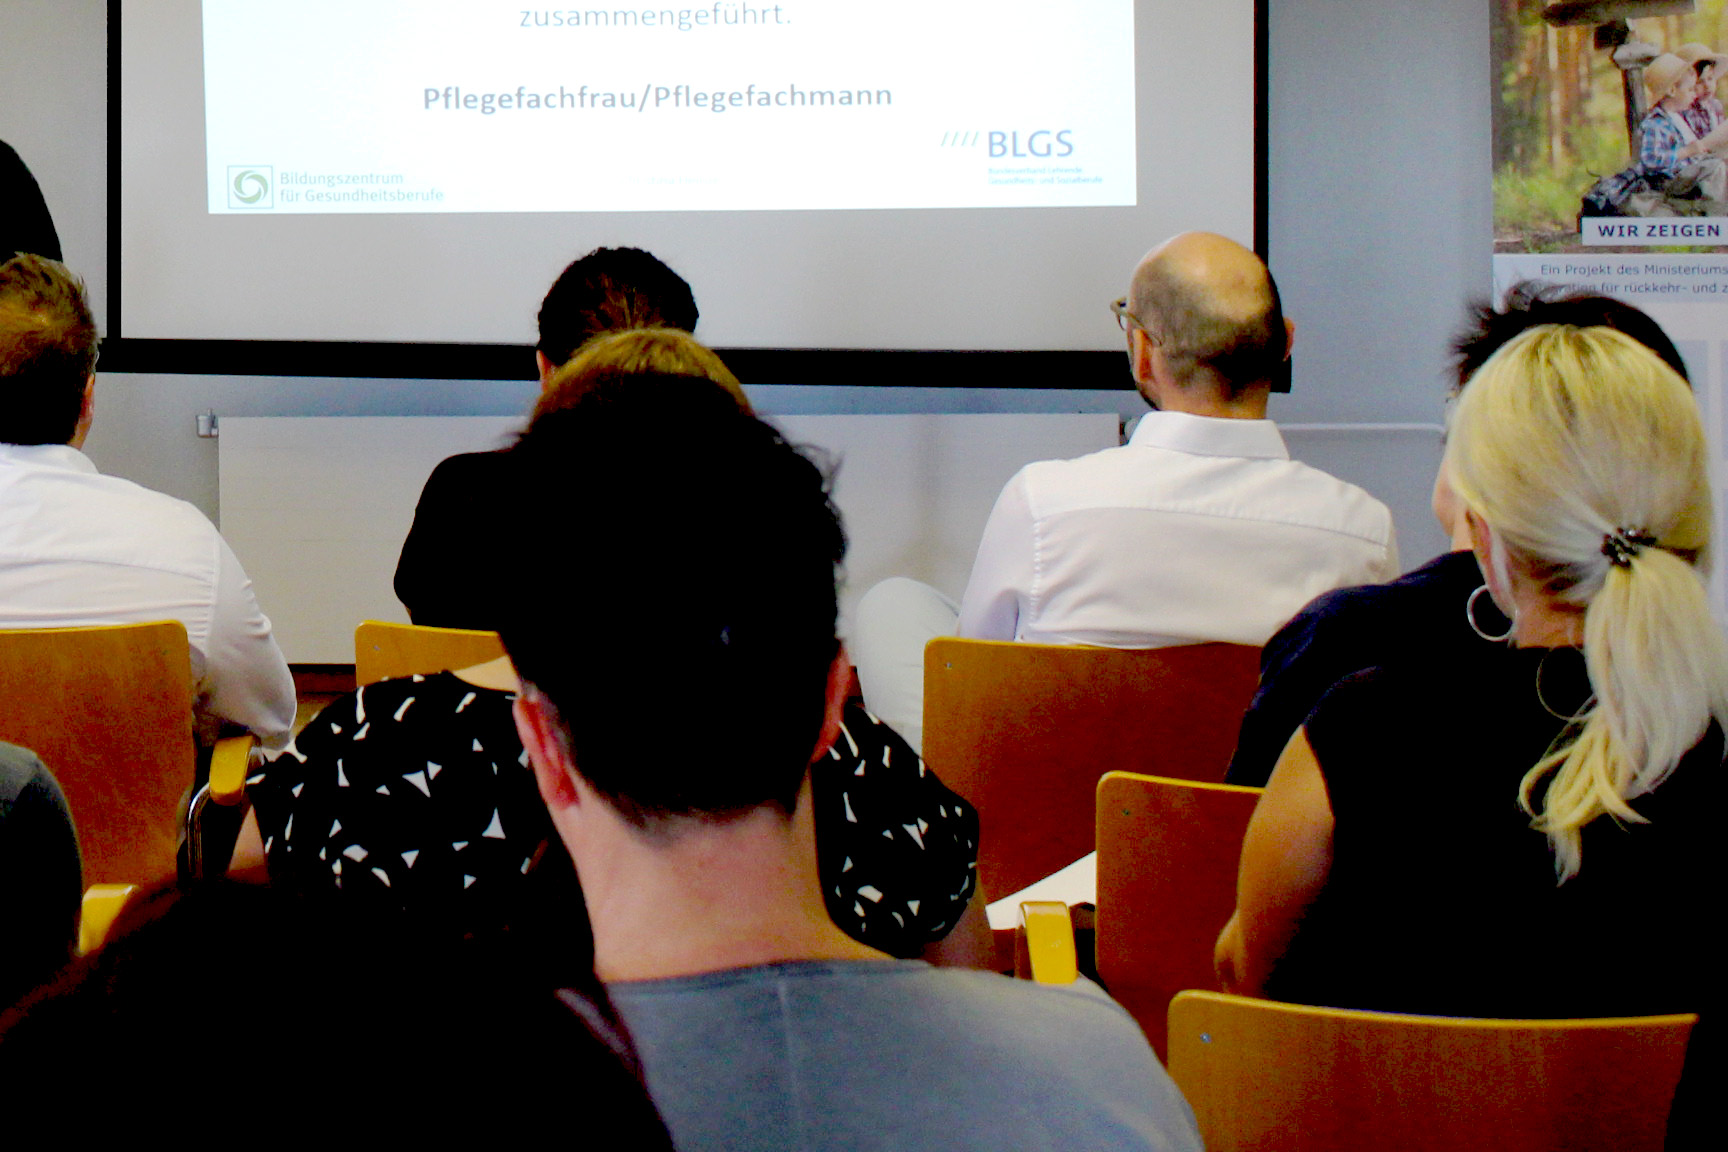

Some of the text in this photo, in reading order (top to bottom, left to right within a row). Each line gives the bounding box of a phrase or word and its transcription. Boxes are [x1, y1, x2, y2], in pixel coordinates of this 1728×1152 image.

[520, 1, 791, 32] zusammengeführt.
[424, 83, 892, 114] Pflegefachfrau/Pflegefachmann
[988, 129, 1074, 158] BLGS
[280, 172, 403, 188] Bildungszentrum
[280, 188, 444, 202] für Gesundheitsberufe
[1598, 224, 1720, 237] WIR ZEIGEN
[1541, 264, 1560, 275] Ein
[1565, 264, 1611, 277] Projekt
[1617, 264, 1639, 275] des
[1601, 282, 1620, 294] für
[1624, 281, 1687, 294] rückkehr-
[1692, 282, 1716, 294] und
